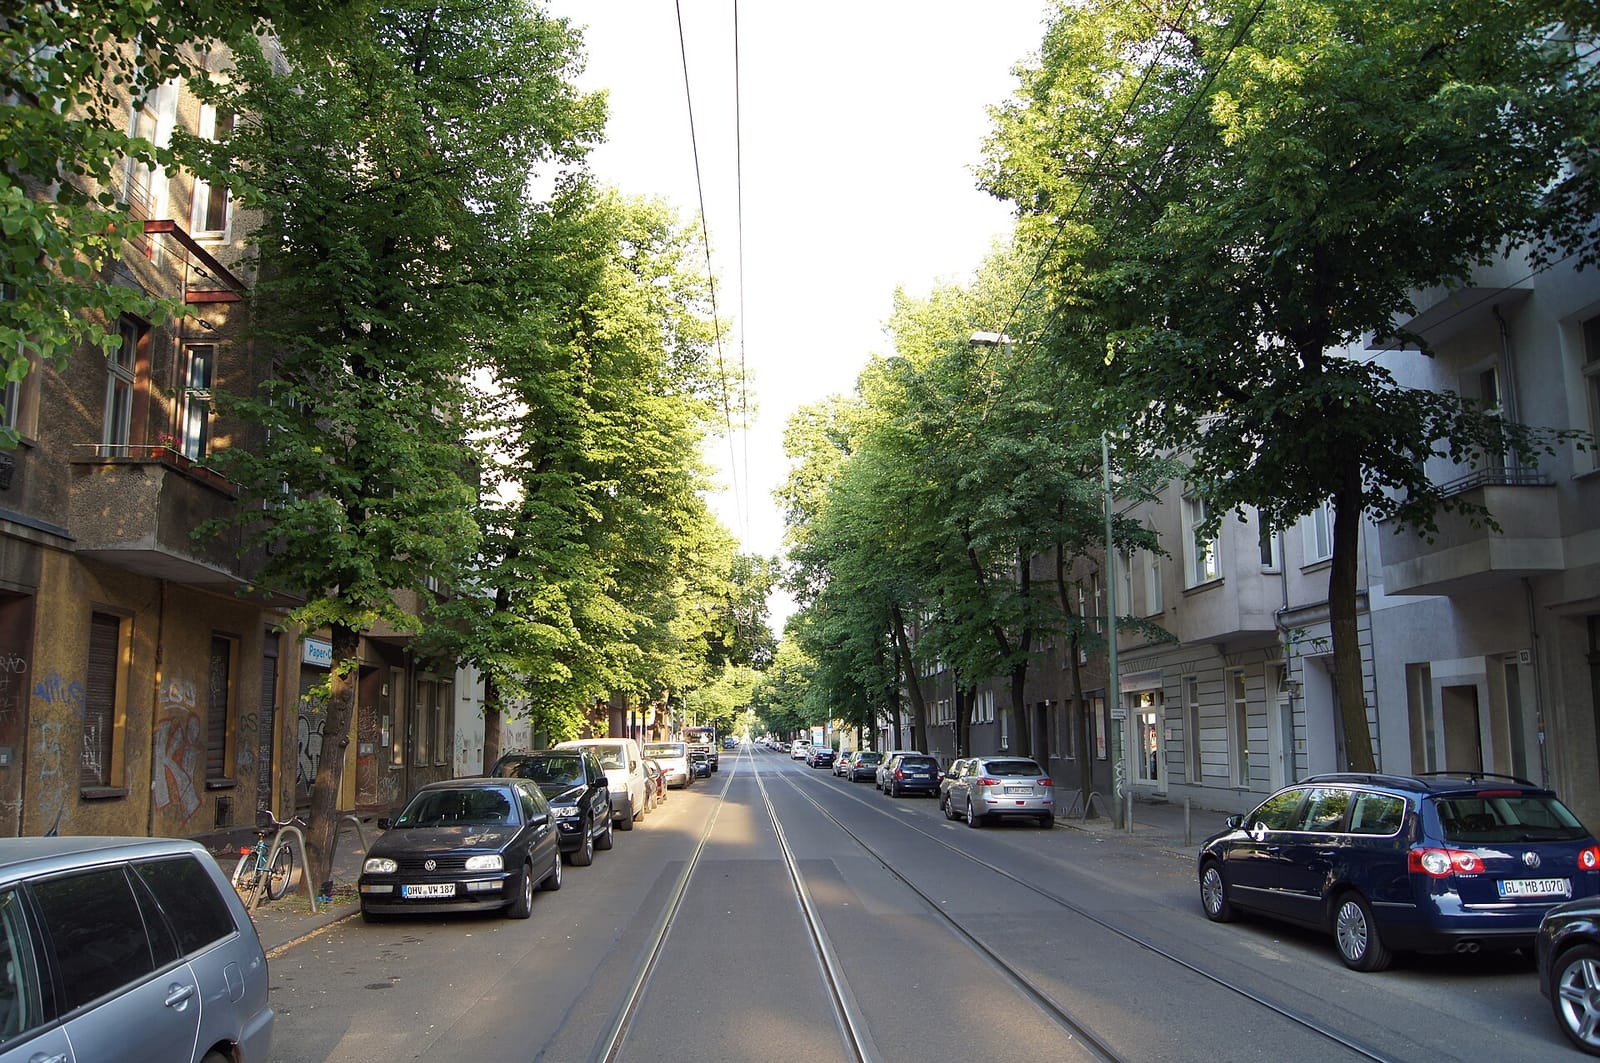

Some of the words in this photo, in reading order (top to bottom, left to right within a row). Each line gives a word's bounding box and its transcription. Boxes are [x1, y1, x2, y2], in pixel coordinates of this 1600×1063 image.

[407, 886, 422, 895] OHV
[427, 885, 438, 894] VW
[440, 885, 454, 894] 187
[1505, 881, 1518, 894] GL
[1525, 881, 1538, 893] MB
[1540, 880, 1563, 892] 1070
